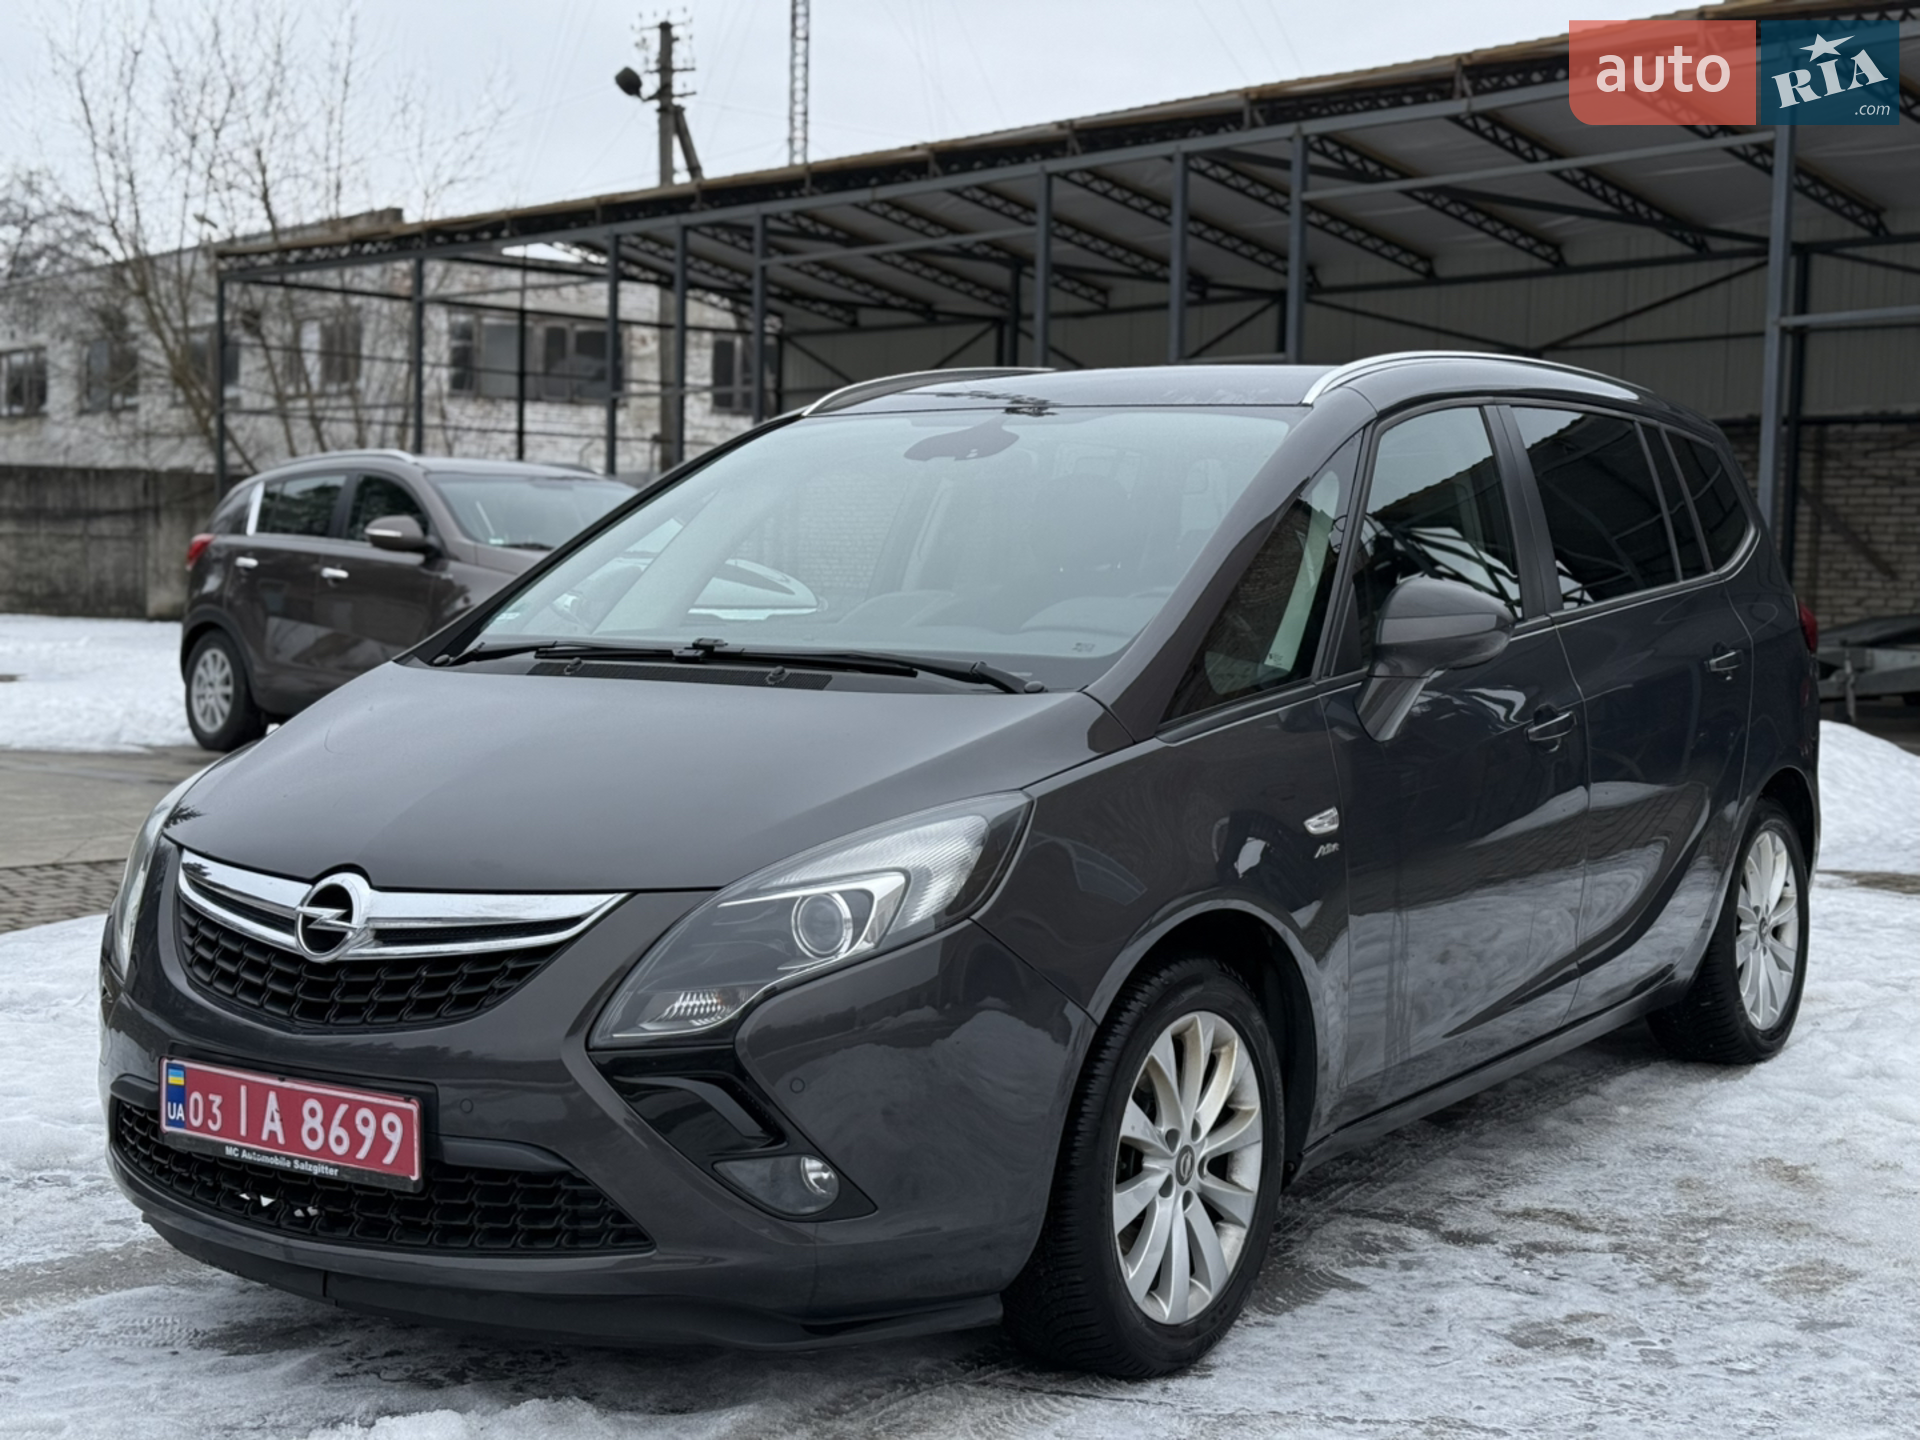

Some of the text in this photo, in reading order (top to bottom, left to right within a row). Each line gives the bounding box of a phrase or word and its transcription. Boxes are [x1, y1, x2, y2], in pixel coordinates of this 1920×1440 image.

[167, 1102, 185, 1122] UA
[188, 1091, 223, 1132] 03
[301, 1098, 404, 1166] 8699
[241, 1149, 291, 1168] Automobile
[293, 1159, 339, 1176] Salzgitter
